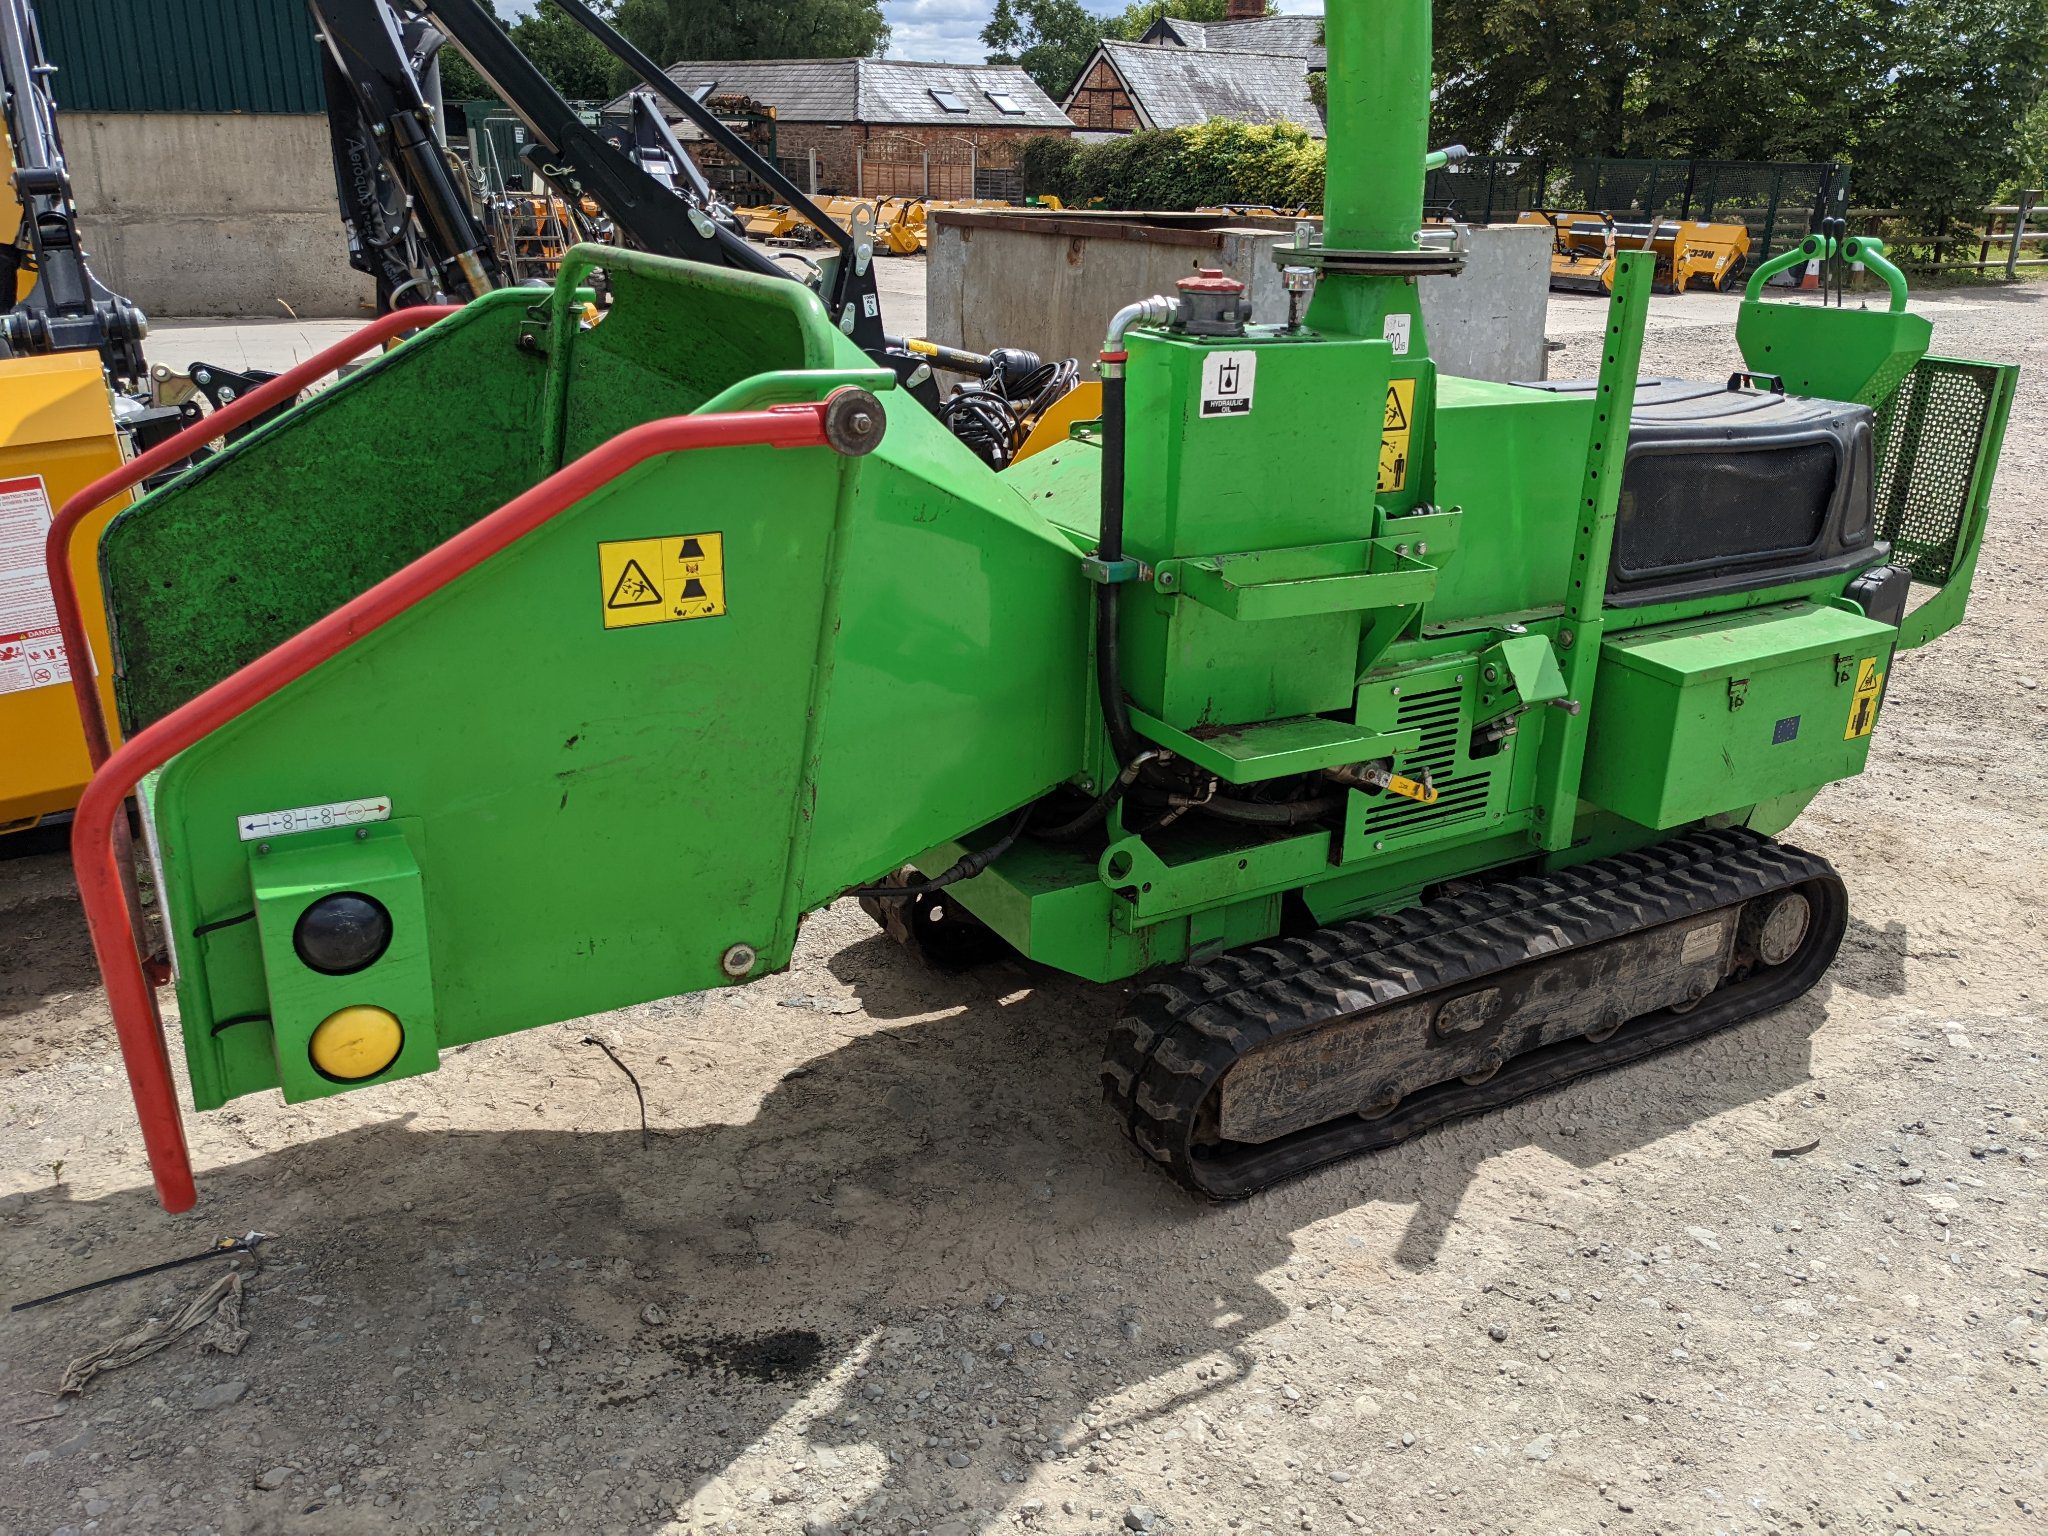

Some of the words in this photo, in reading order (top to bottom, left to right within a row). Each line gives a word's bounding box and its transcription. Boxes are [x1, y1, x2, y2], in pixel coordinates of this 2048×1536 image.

[1689, 249, 1715, 259] McC
[1210, 399, 1243, 408] HYDRAULIC
[28, 626, 61, 638] DANGER
